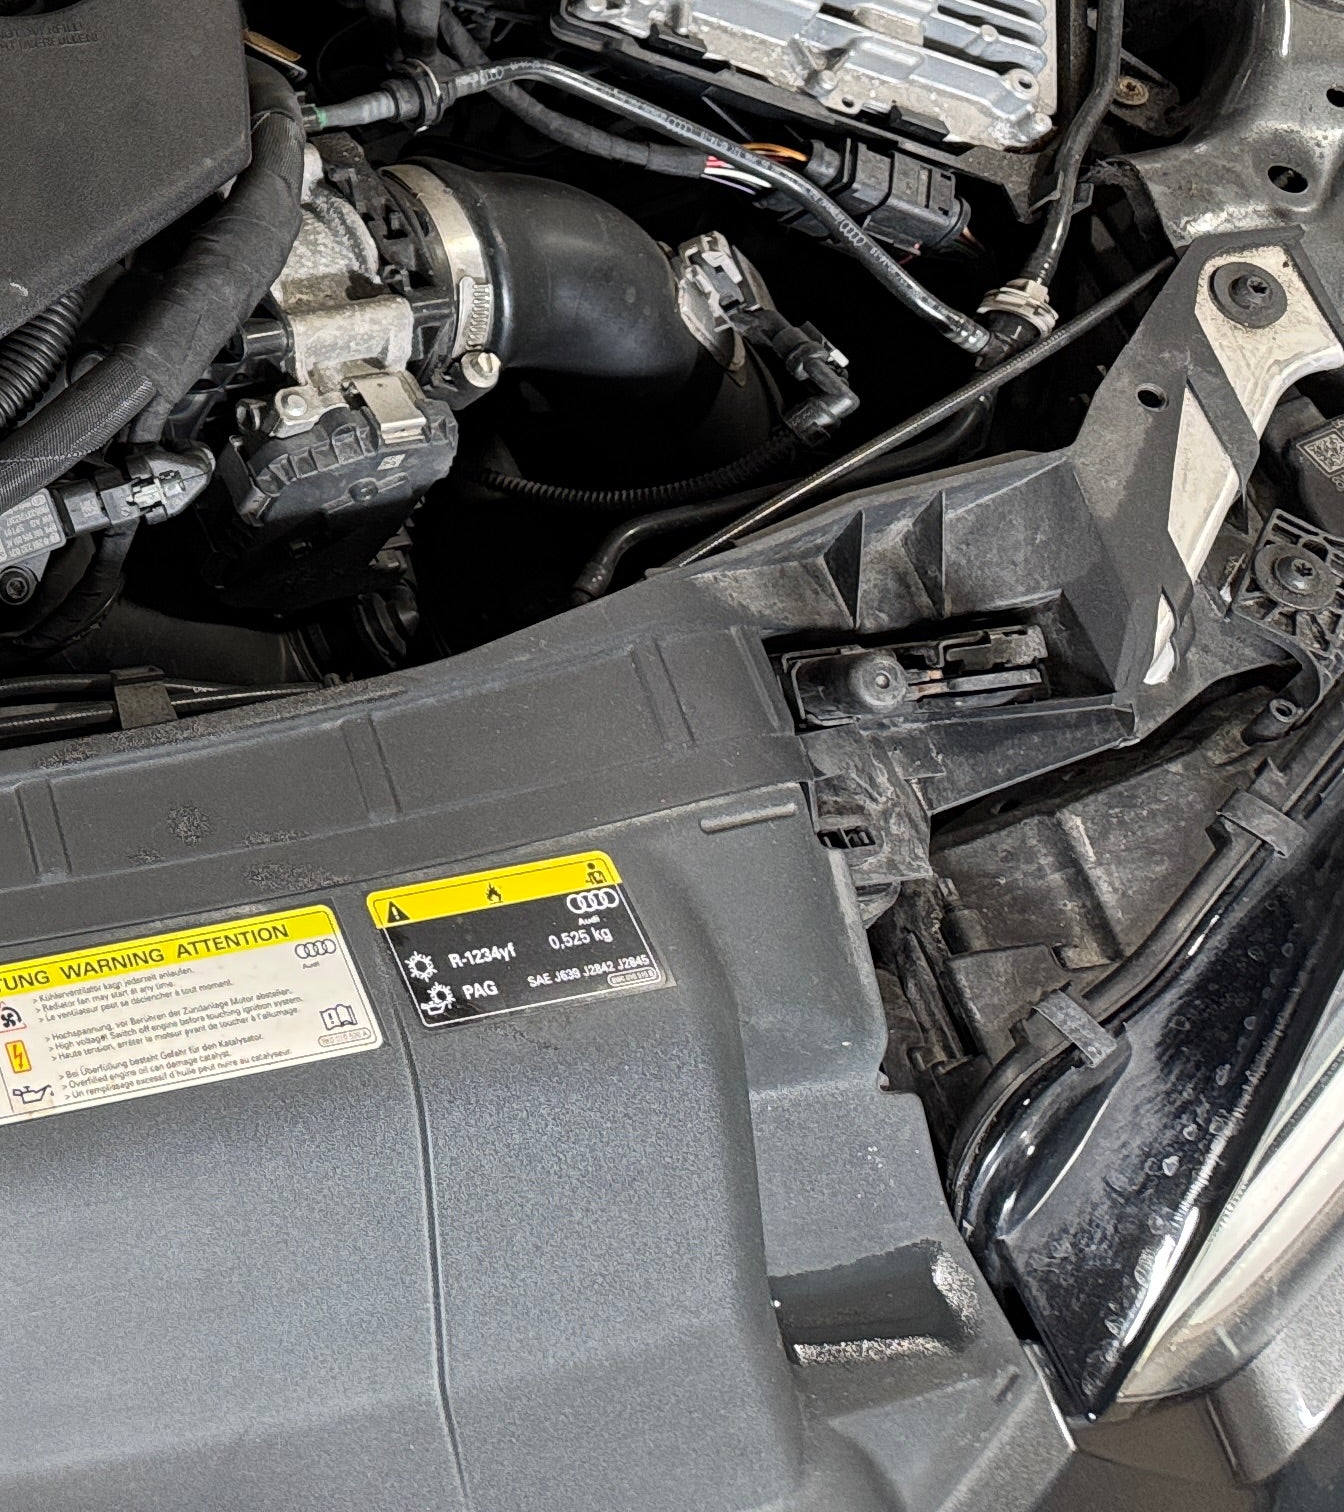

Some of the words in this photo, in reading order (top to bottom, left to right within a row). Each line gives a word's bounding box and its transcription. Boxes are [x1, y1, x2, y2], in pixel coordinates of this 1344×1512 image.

[576, 915, 602, 926] Audi
[547, 929, 592, 951] 0,525
[589, 924, 614, 944] kg
[60, 947, 165, 980] WARNING
[173, 923, 289, 958] ATTENTION
[446, 942, 520, 970] R-1234yf
[526, 973, 553, 987] SAE
[551, 967, 582, 982] J639
[579, 961, 616, 977] J2842
[614, 954, 651, 970] J2845
[461, 980, 500, 999] PAG
